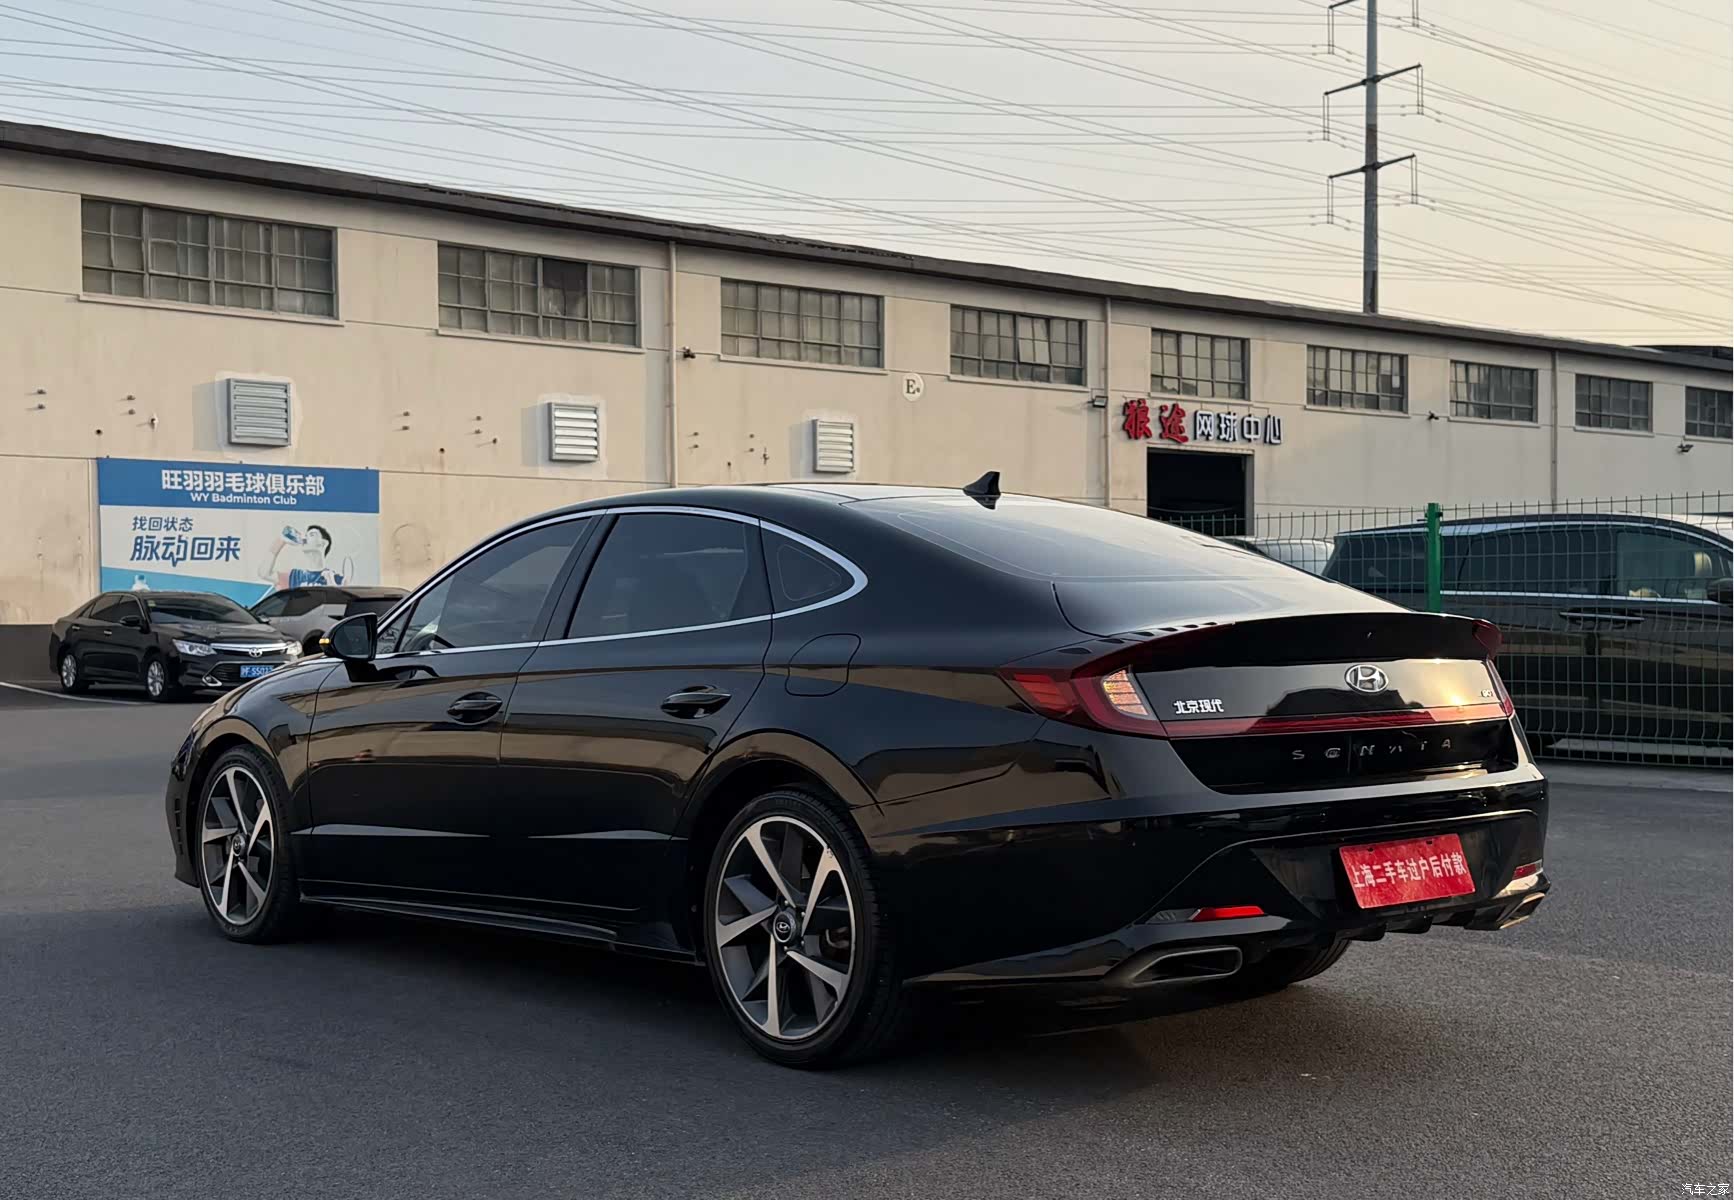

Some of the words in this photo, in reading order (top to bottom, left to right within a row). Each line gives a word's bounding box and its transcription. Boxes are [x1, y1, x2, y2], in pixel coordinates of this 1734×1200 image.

[161, 469, 325, 496] 旺羽羽毛球俱乐部
[190, 493, 209, 502] WY
[211, 493, 271, 504] Badminton
[273, 495, 297, 505] Club
[132, 516, 194, 532] 找回状态
[129, 535, 241, 567] 脉动回来
[1173, 699, 1224, 714] 北京现代
[1351, 852, 1467, 888] 上海二手车过户后付款
